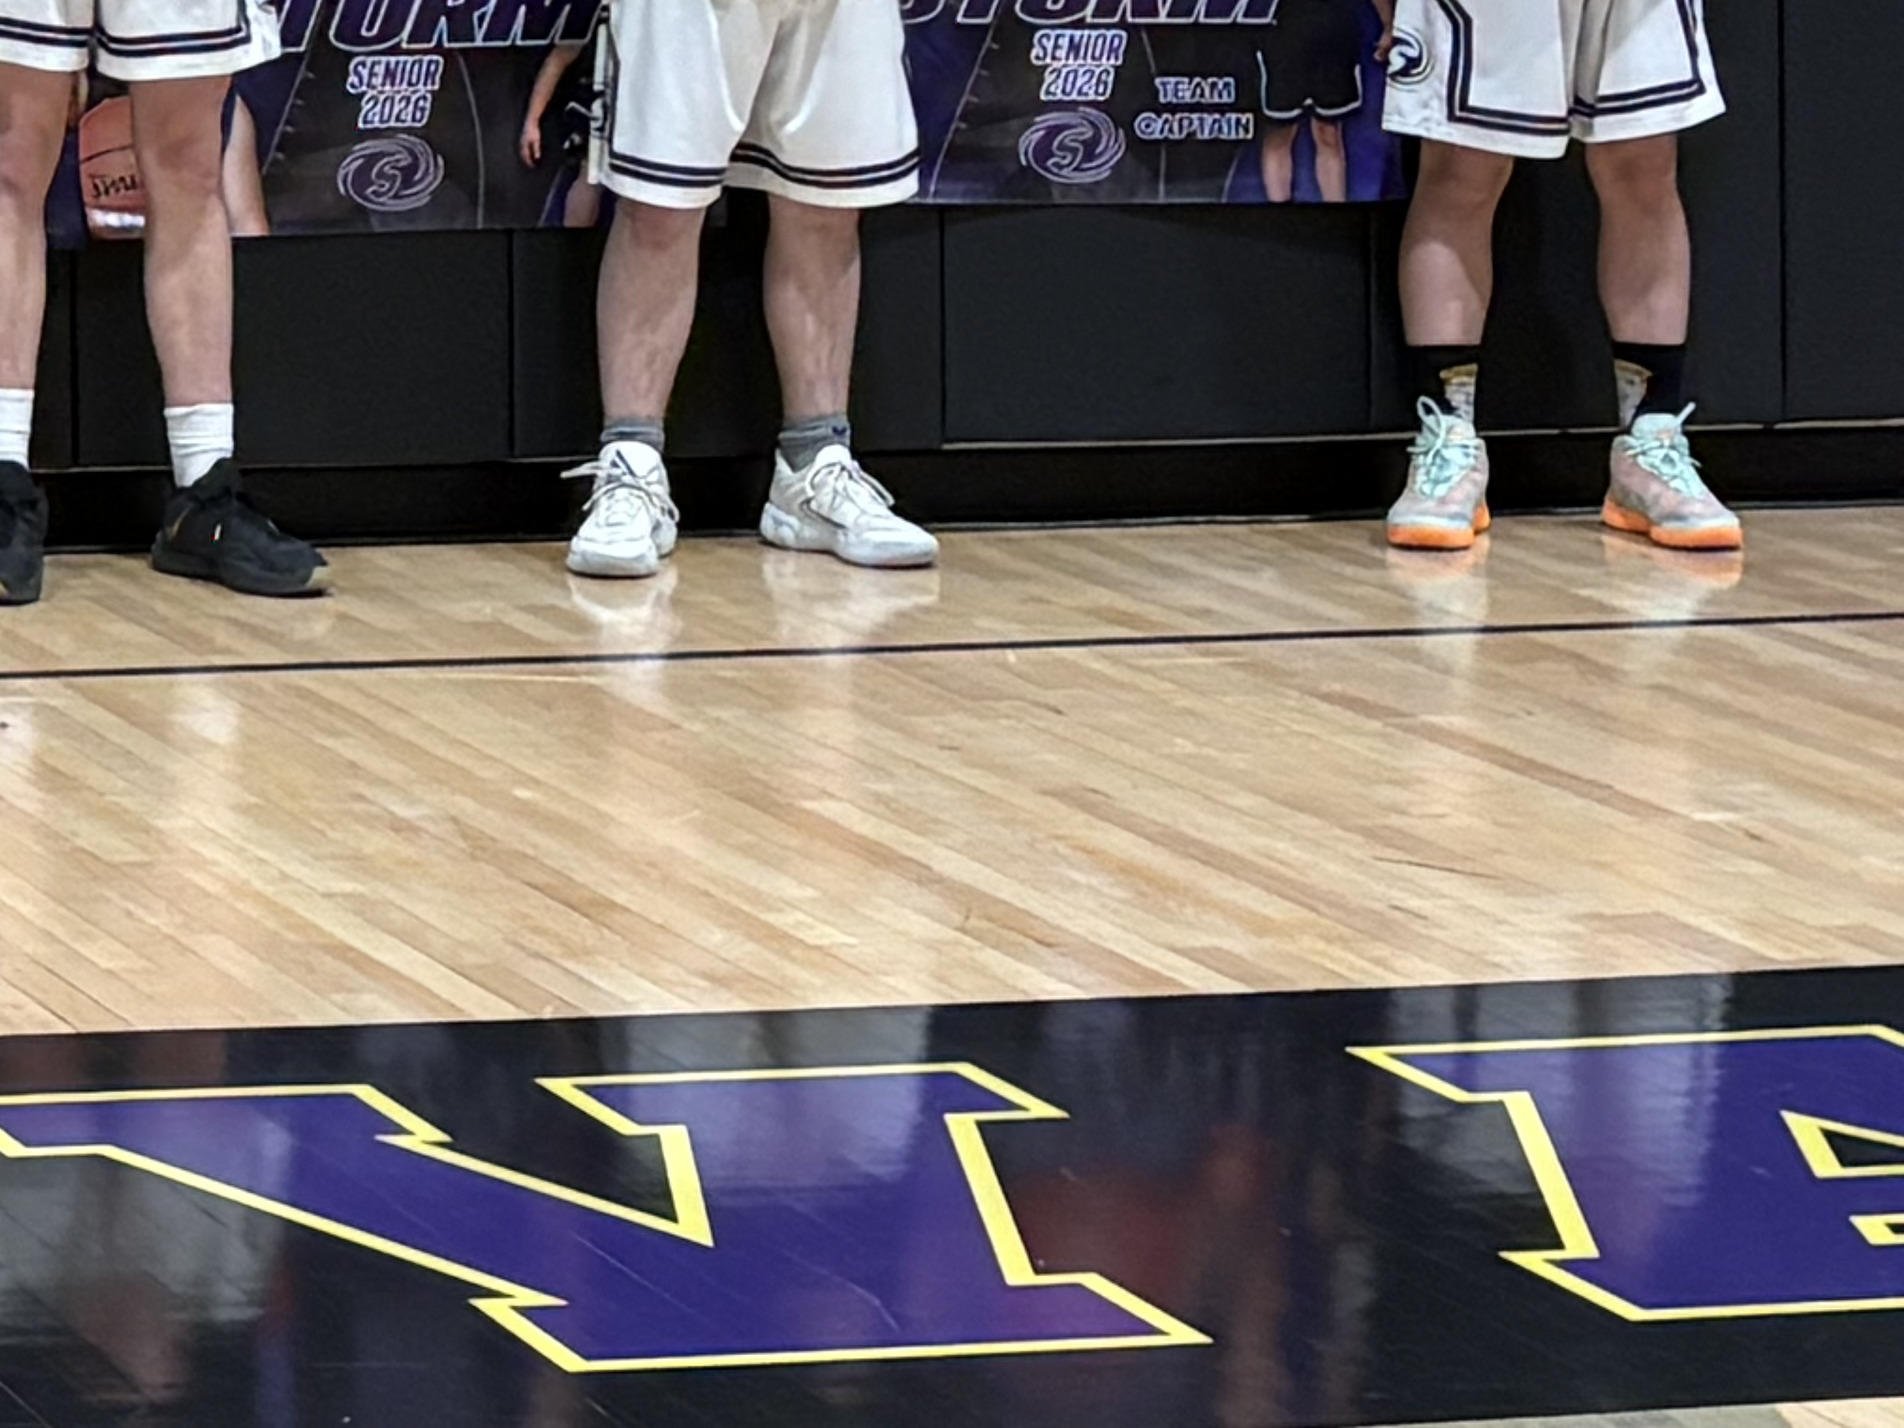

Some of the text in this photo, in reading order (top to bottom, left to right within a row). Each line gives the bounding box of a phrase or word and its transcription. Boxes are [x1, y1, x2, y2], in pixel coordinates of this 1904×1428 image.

[1030, 29, 1128, 68] SENIOR
[346, 55, 444, 94] SENIOR
[1040, 64, 1115, 101] 2026
[1155, 76, 1235, 104] TEAM
[357, 92, 432, 129] 2026
[1134, 112, 1254, 140] CAPTAIN
